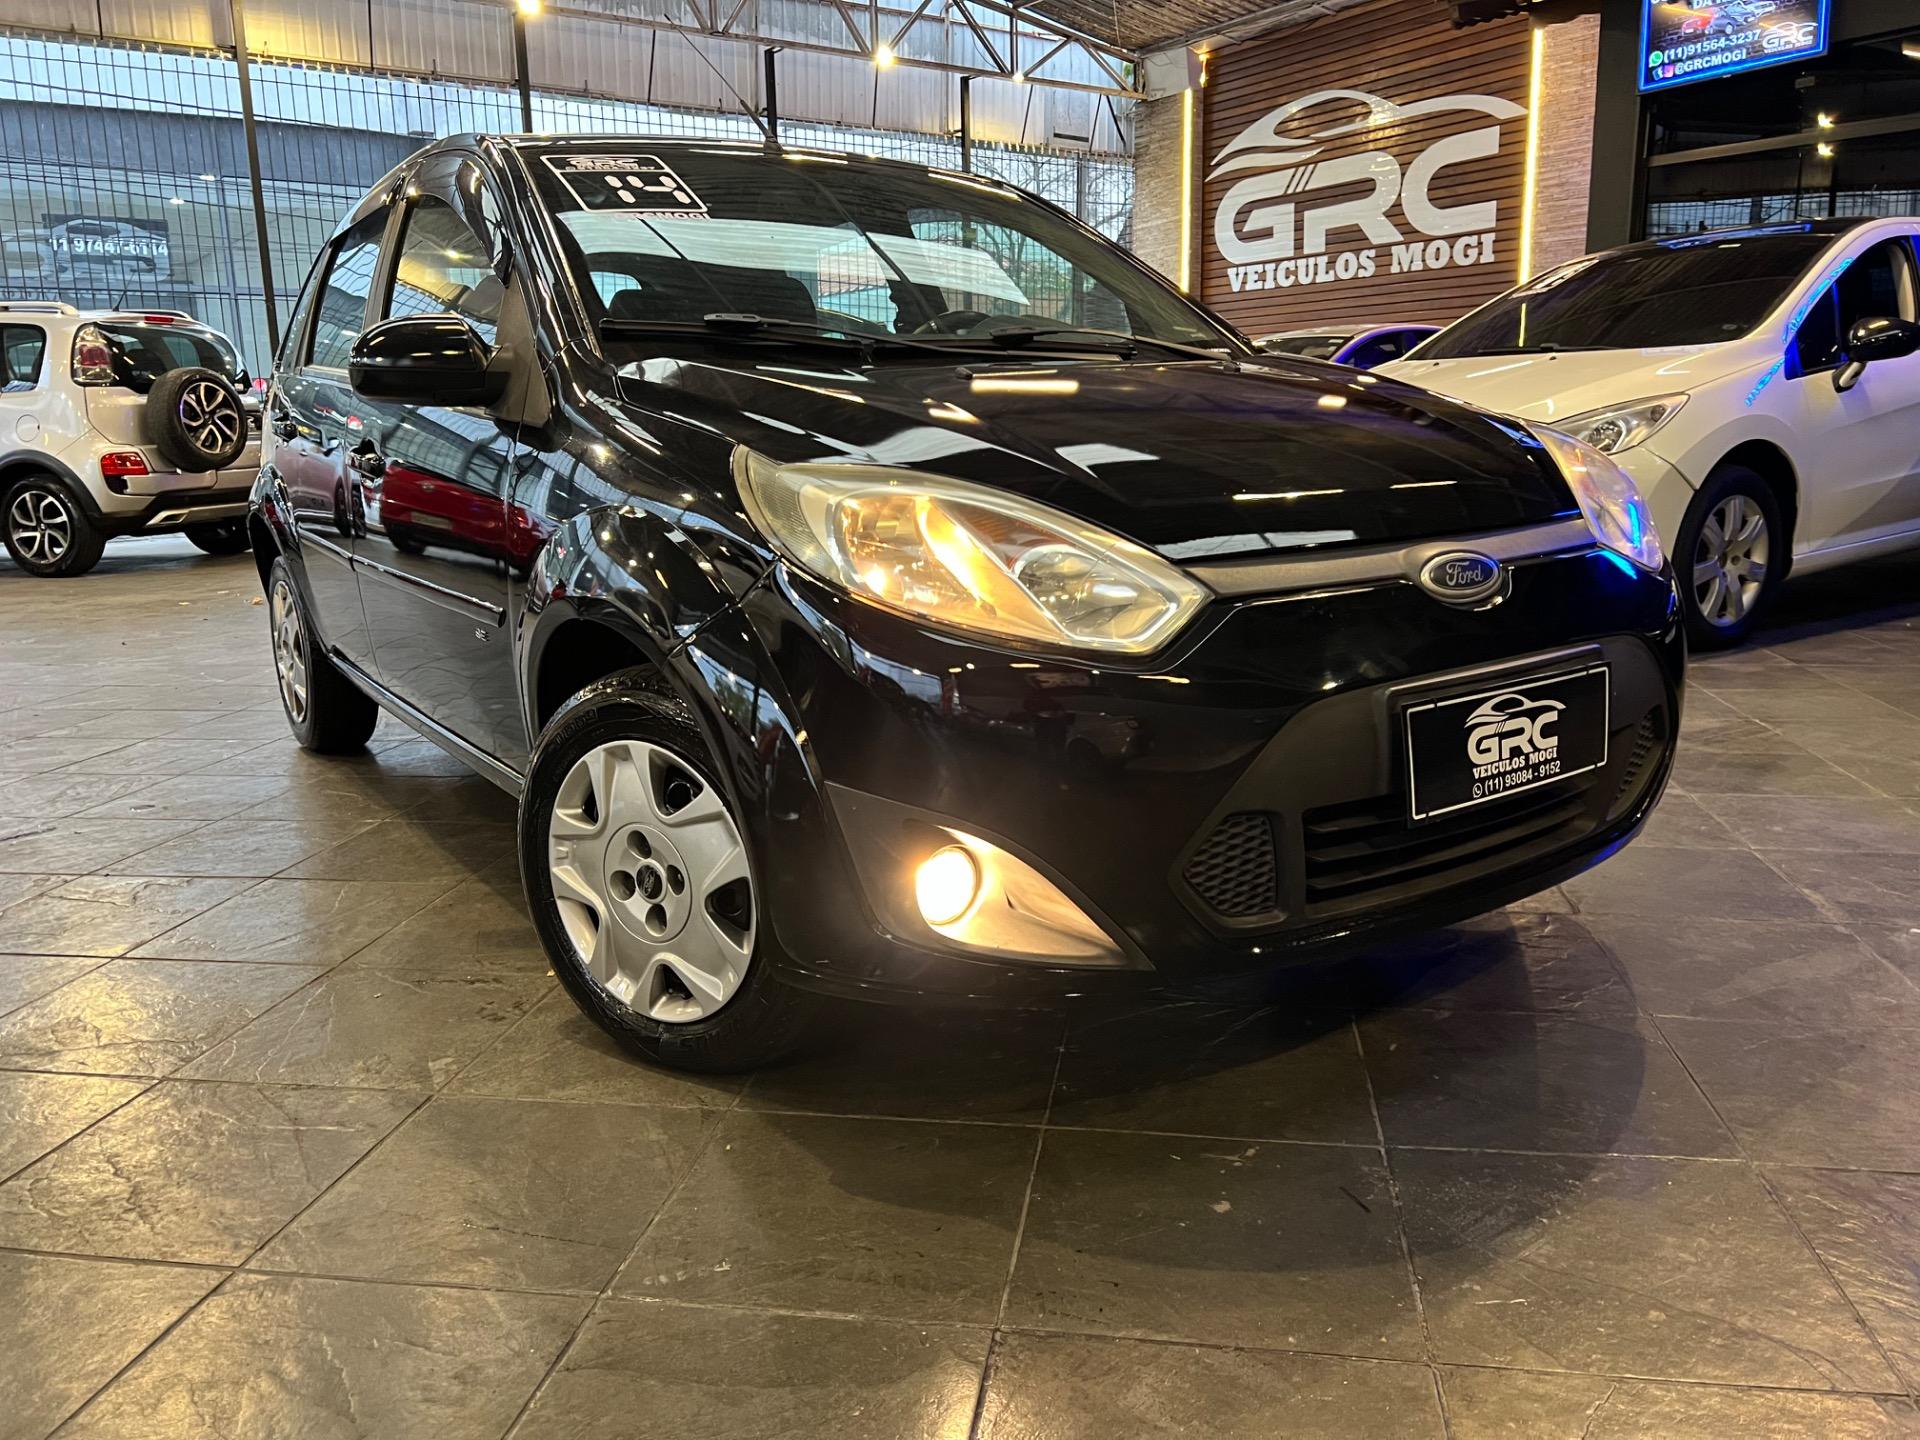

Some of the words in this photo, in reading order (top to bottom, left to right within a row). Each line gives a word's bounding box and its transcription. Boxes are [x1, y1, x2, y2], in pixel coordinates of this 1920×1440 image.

[1664, 29, 1761, 63] (11)91564-3237
[1674, 48, 1747, 75] @GRCMOGI
[1214, 125, 1500, 265] GRC
[1227, 249, 1377, 293] VEICULOS
[1391, 232, 1496, 274] MOGI
[1446, 561, 1485, 586] Ford
[1467, 710, 1559, 765] GRC
[1472, 755, 1526, 779] VEICULOS
[1529, 747, 1557, 765] MOGI
[1485, 776, 1503, 795] (11)
